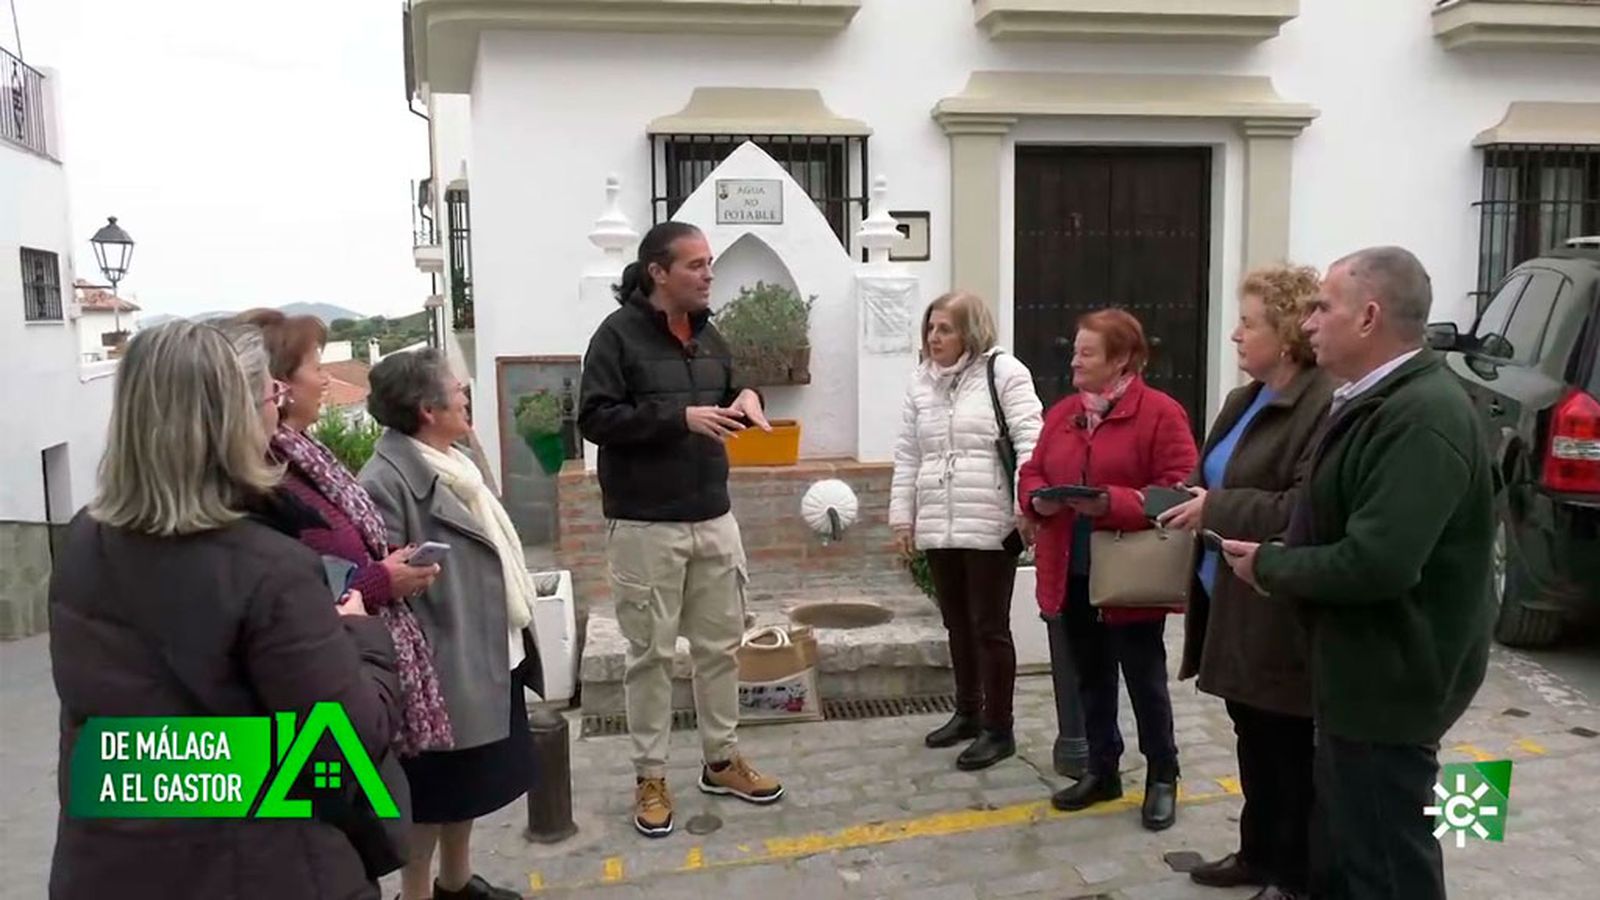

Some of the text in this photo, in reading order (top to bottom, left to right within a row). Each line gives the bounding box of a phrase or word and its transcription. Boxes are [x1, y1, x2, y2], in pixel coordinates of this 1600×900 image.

[737, 186, 765, 194] AGUA
[743, 199, 759, 207] NO
[723, 210, 774, 220] POTABLE
